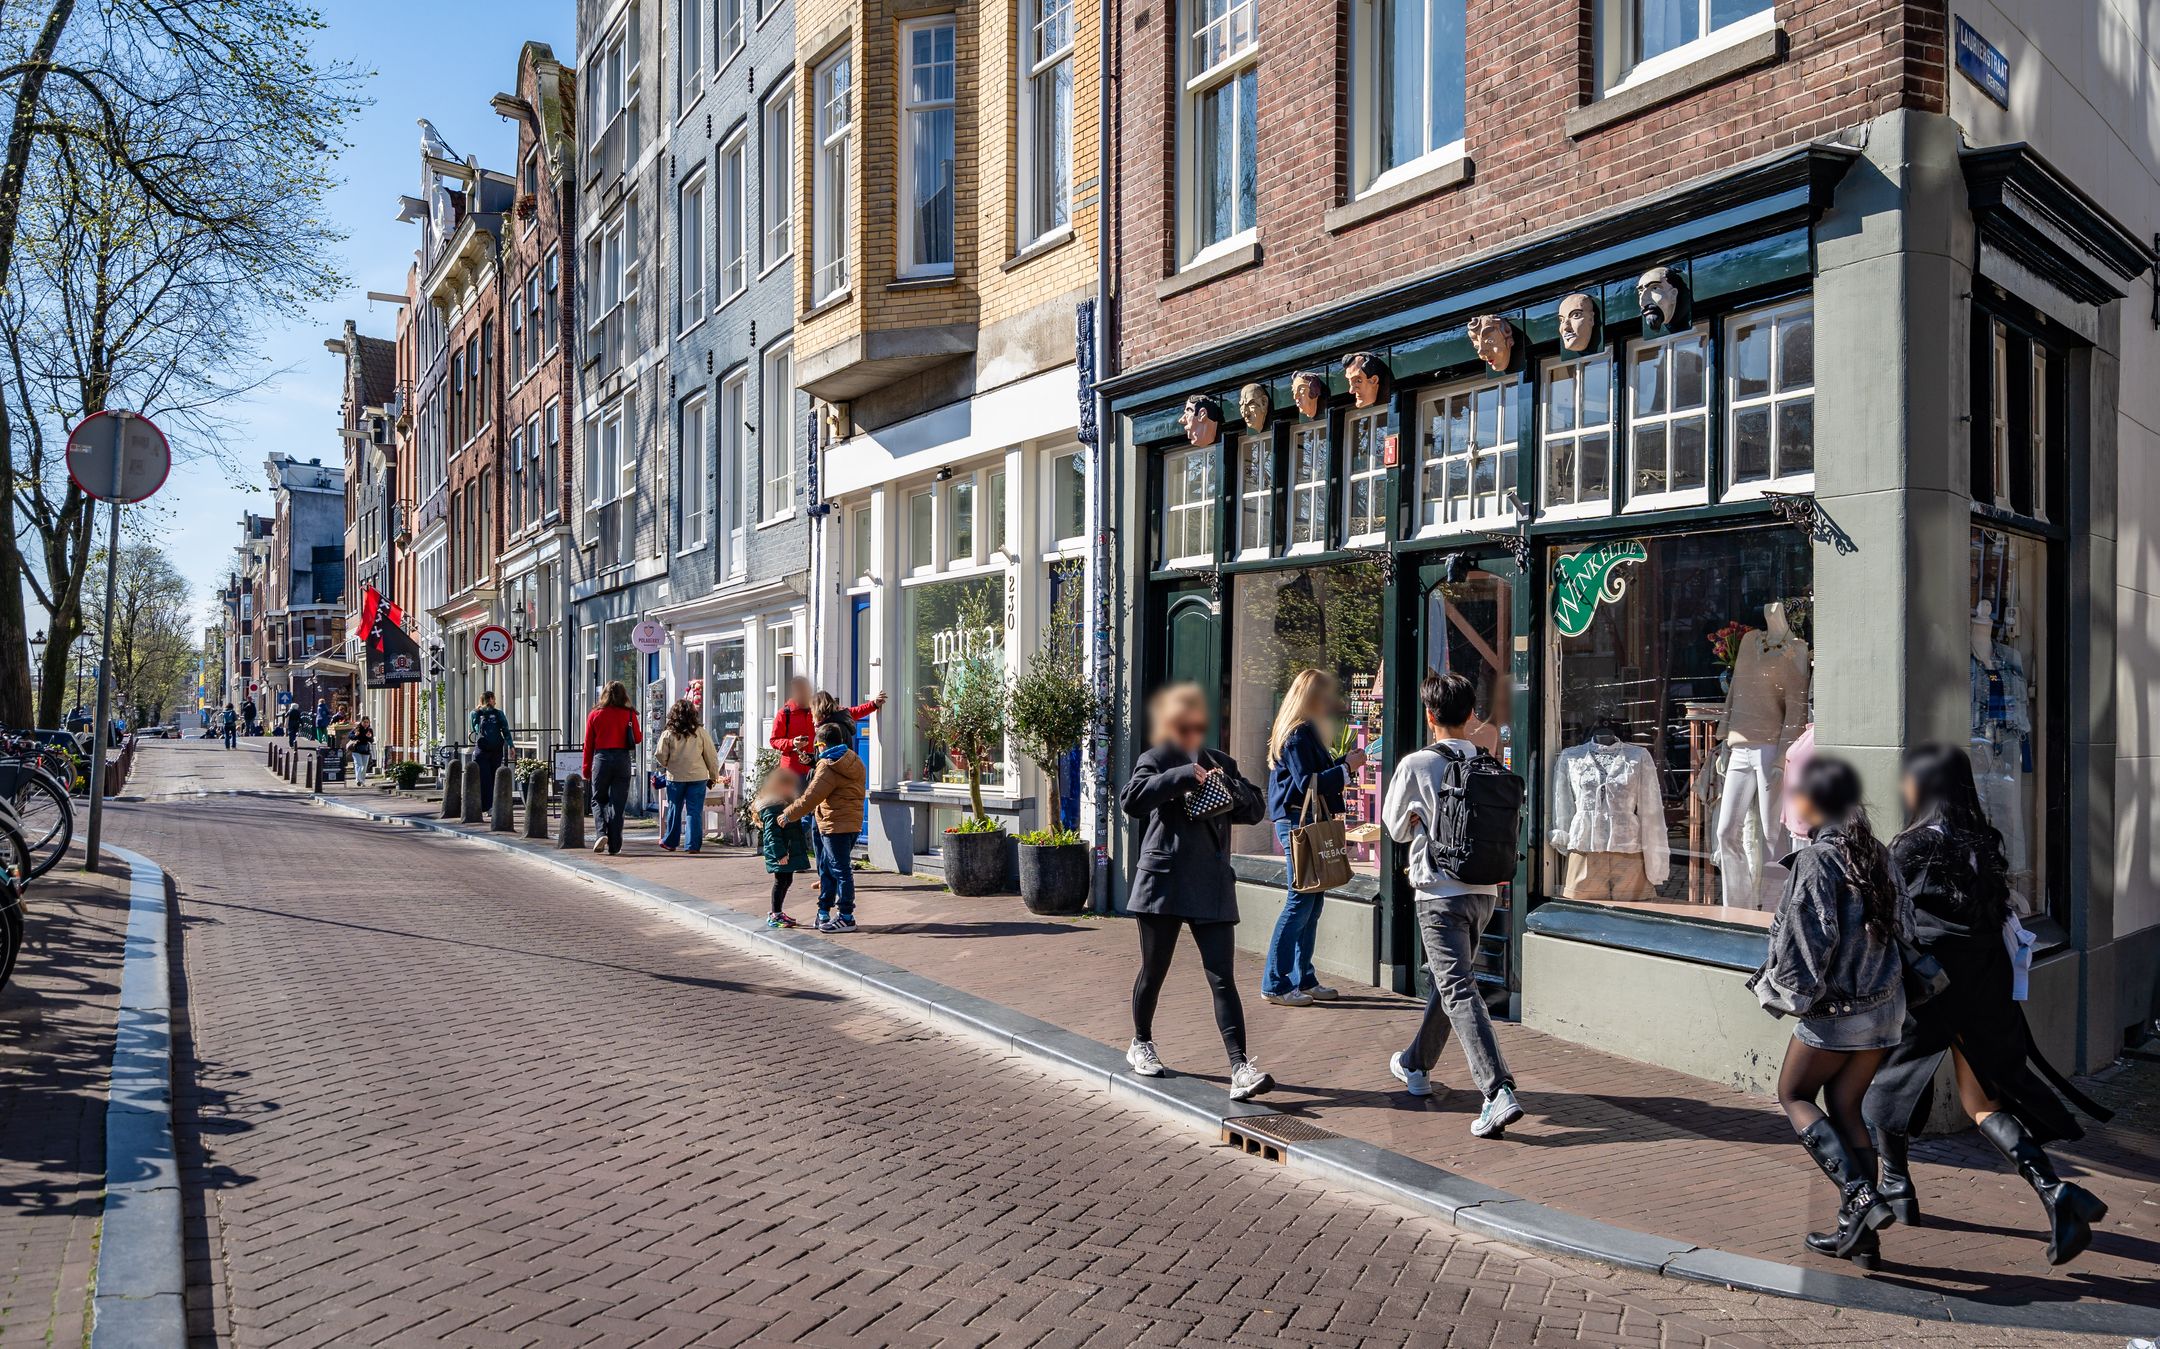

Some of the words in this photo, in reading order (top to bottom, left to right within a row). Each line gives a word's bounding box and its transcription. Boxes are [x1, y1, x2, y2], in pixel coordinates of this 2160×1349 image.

[1960, 25, 2008, 82] LAURIERSTRAAT
[1007, 575, 1015, 631] 230
[1553, 541, 1639, 631] WINKELTJE
